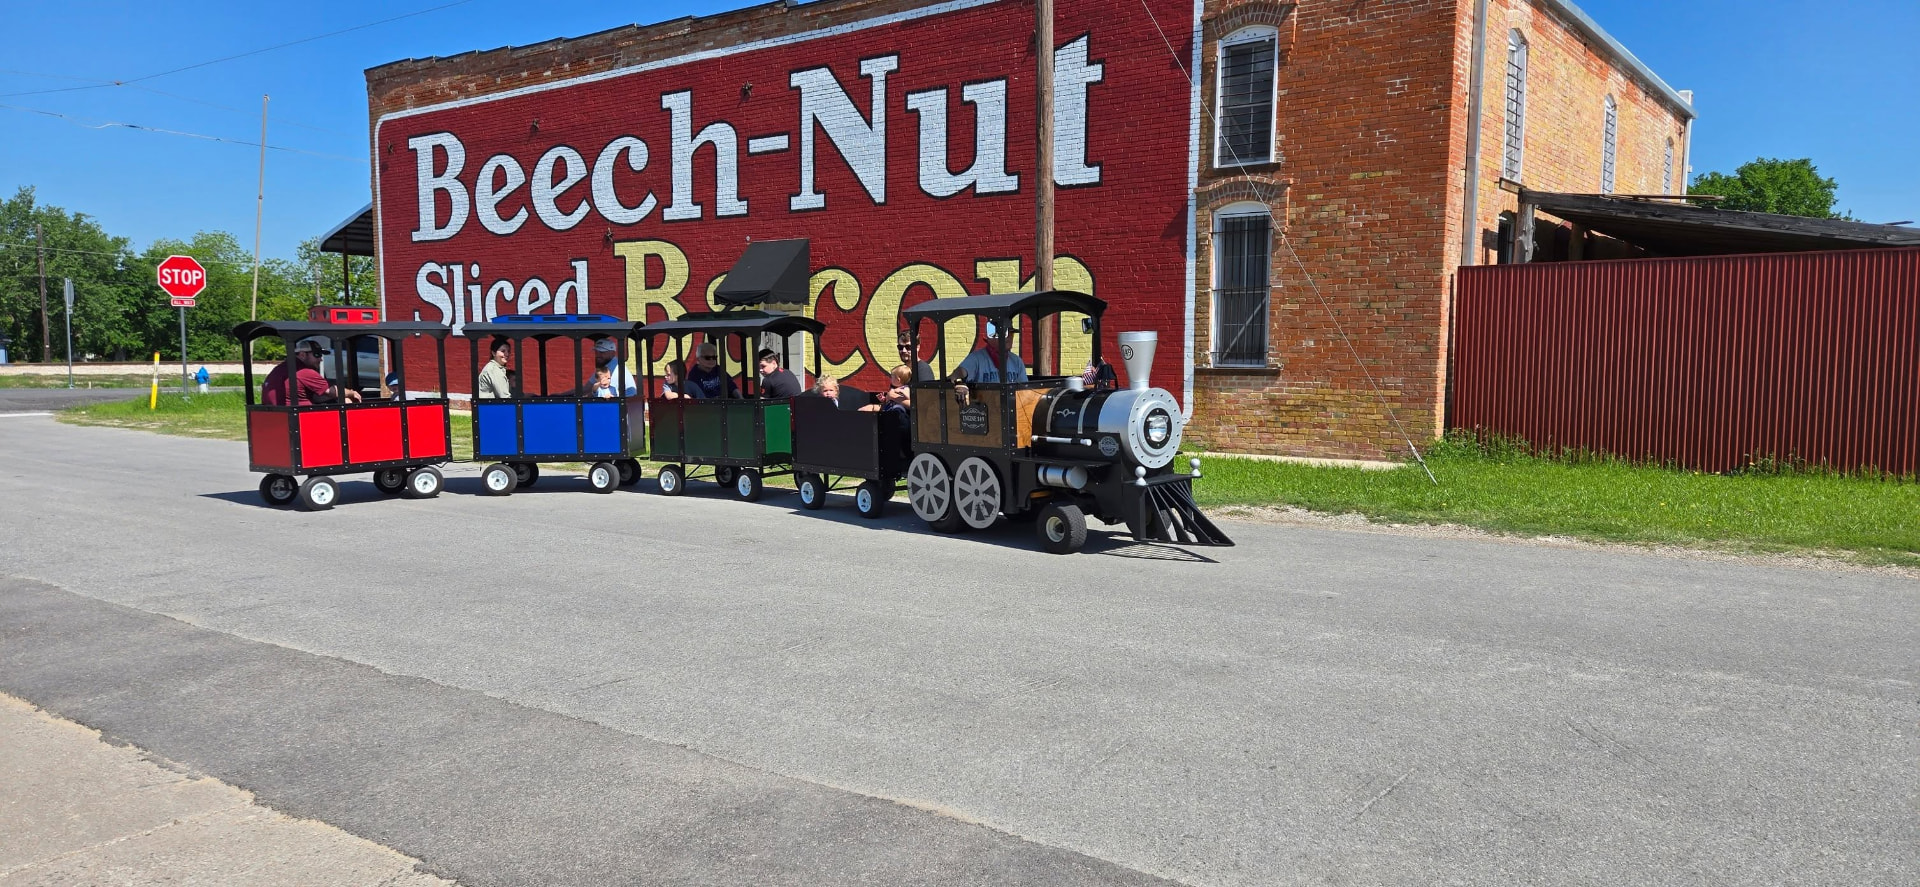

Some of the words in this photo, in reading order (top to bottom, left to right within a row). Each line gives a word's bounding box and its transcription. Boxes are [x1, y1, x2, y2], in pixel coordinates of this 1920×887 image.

[409, 34, 1104, 242] Beech-Nut
[161, 268, 202, 285] STOP
[413, 257, 589, 336] Sliced
